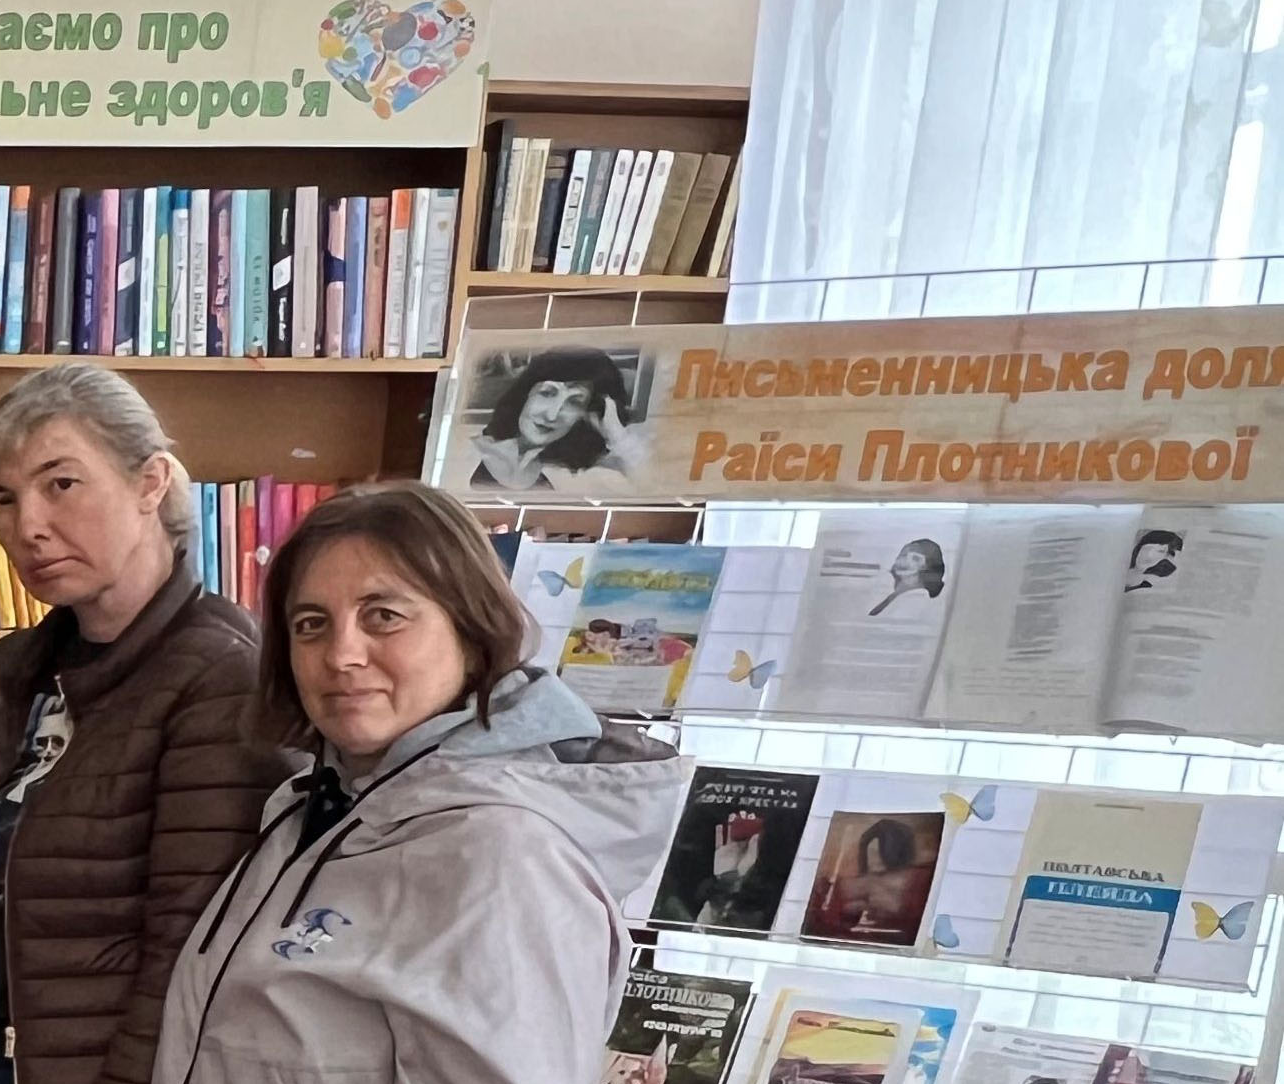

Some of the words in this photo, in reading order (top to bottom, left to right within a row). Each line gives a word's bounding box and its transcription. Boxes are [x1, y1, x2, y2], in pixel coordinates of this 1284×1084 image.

[137, 11, 231, 63] про
[106, 68, 332, 130] здоров'я
[671, 348, 1130, 403] Письменницька
[688, 430, 842, 483] Раїси
[857, 425, 1261, 484] Плотникової
